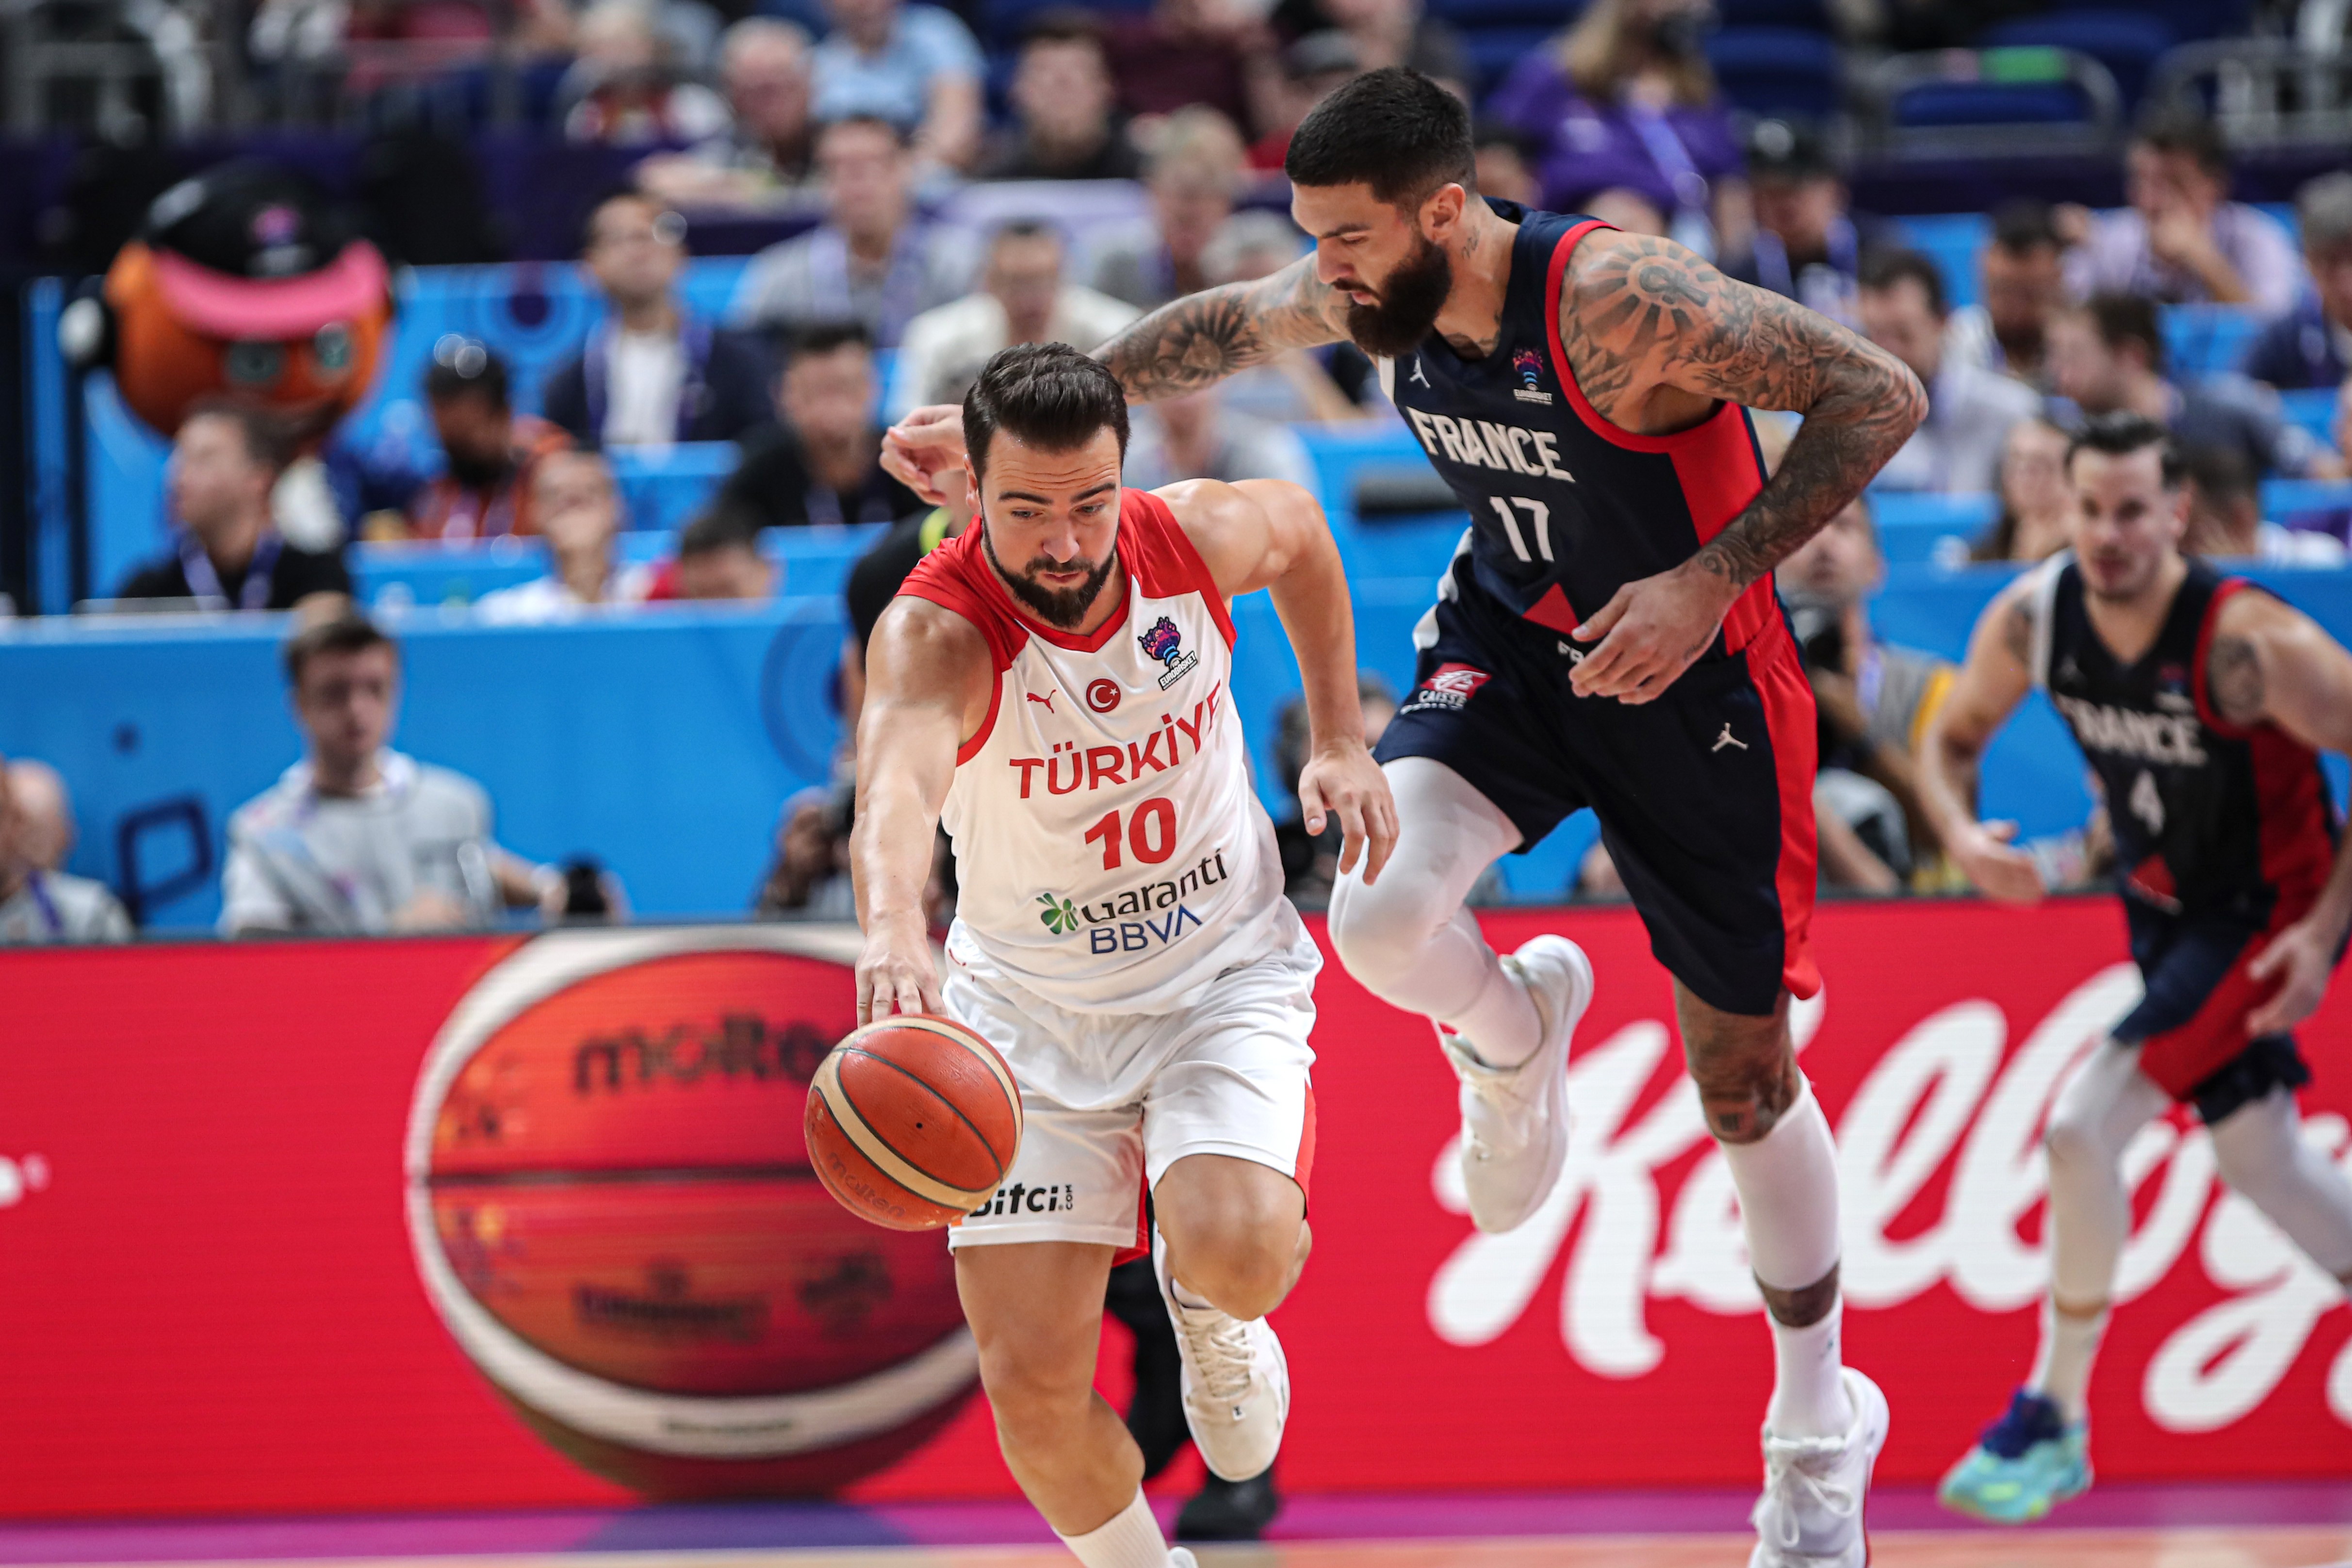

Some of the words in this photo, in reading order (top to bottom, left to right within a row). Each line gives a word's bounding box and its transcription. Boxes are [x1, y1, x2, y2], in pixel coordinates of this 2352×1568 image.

[1406, 406, 1576, 484] FRANCE
[1489, 496, 1554, 563] 17
[1159, 652, 1196, 687] EUROBASKET
[1085, 797, 1177, 870] 10
[2129, 769, 2165, 837] 4
[1081, 848, 1227, 923] Garanti
[1090, 903, 1203, 954] BBVA
[574, 1010, 835, 1095] molte
[826, 1152, 906, 1217] molten
